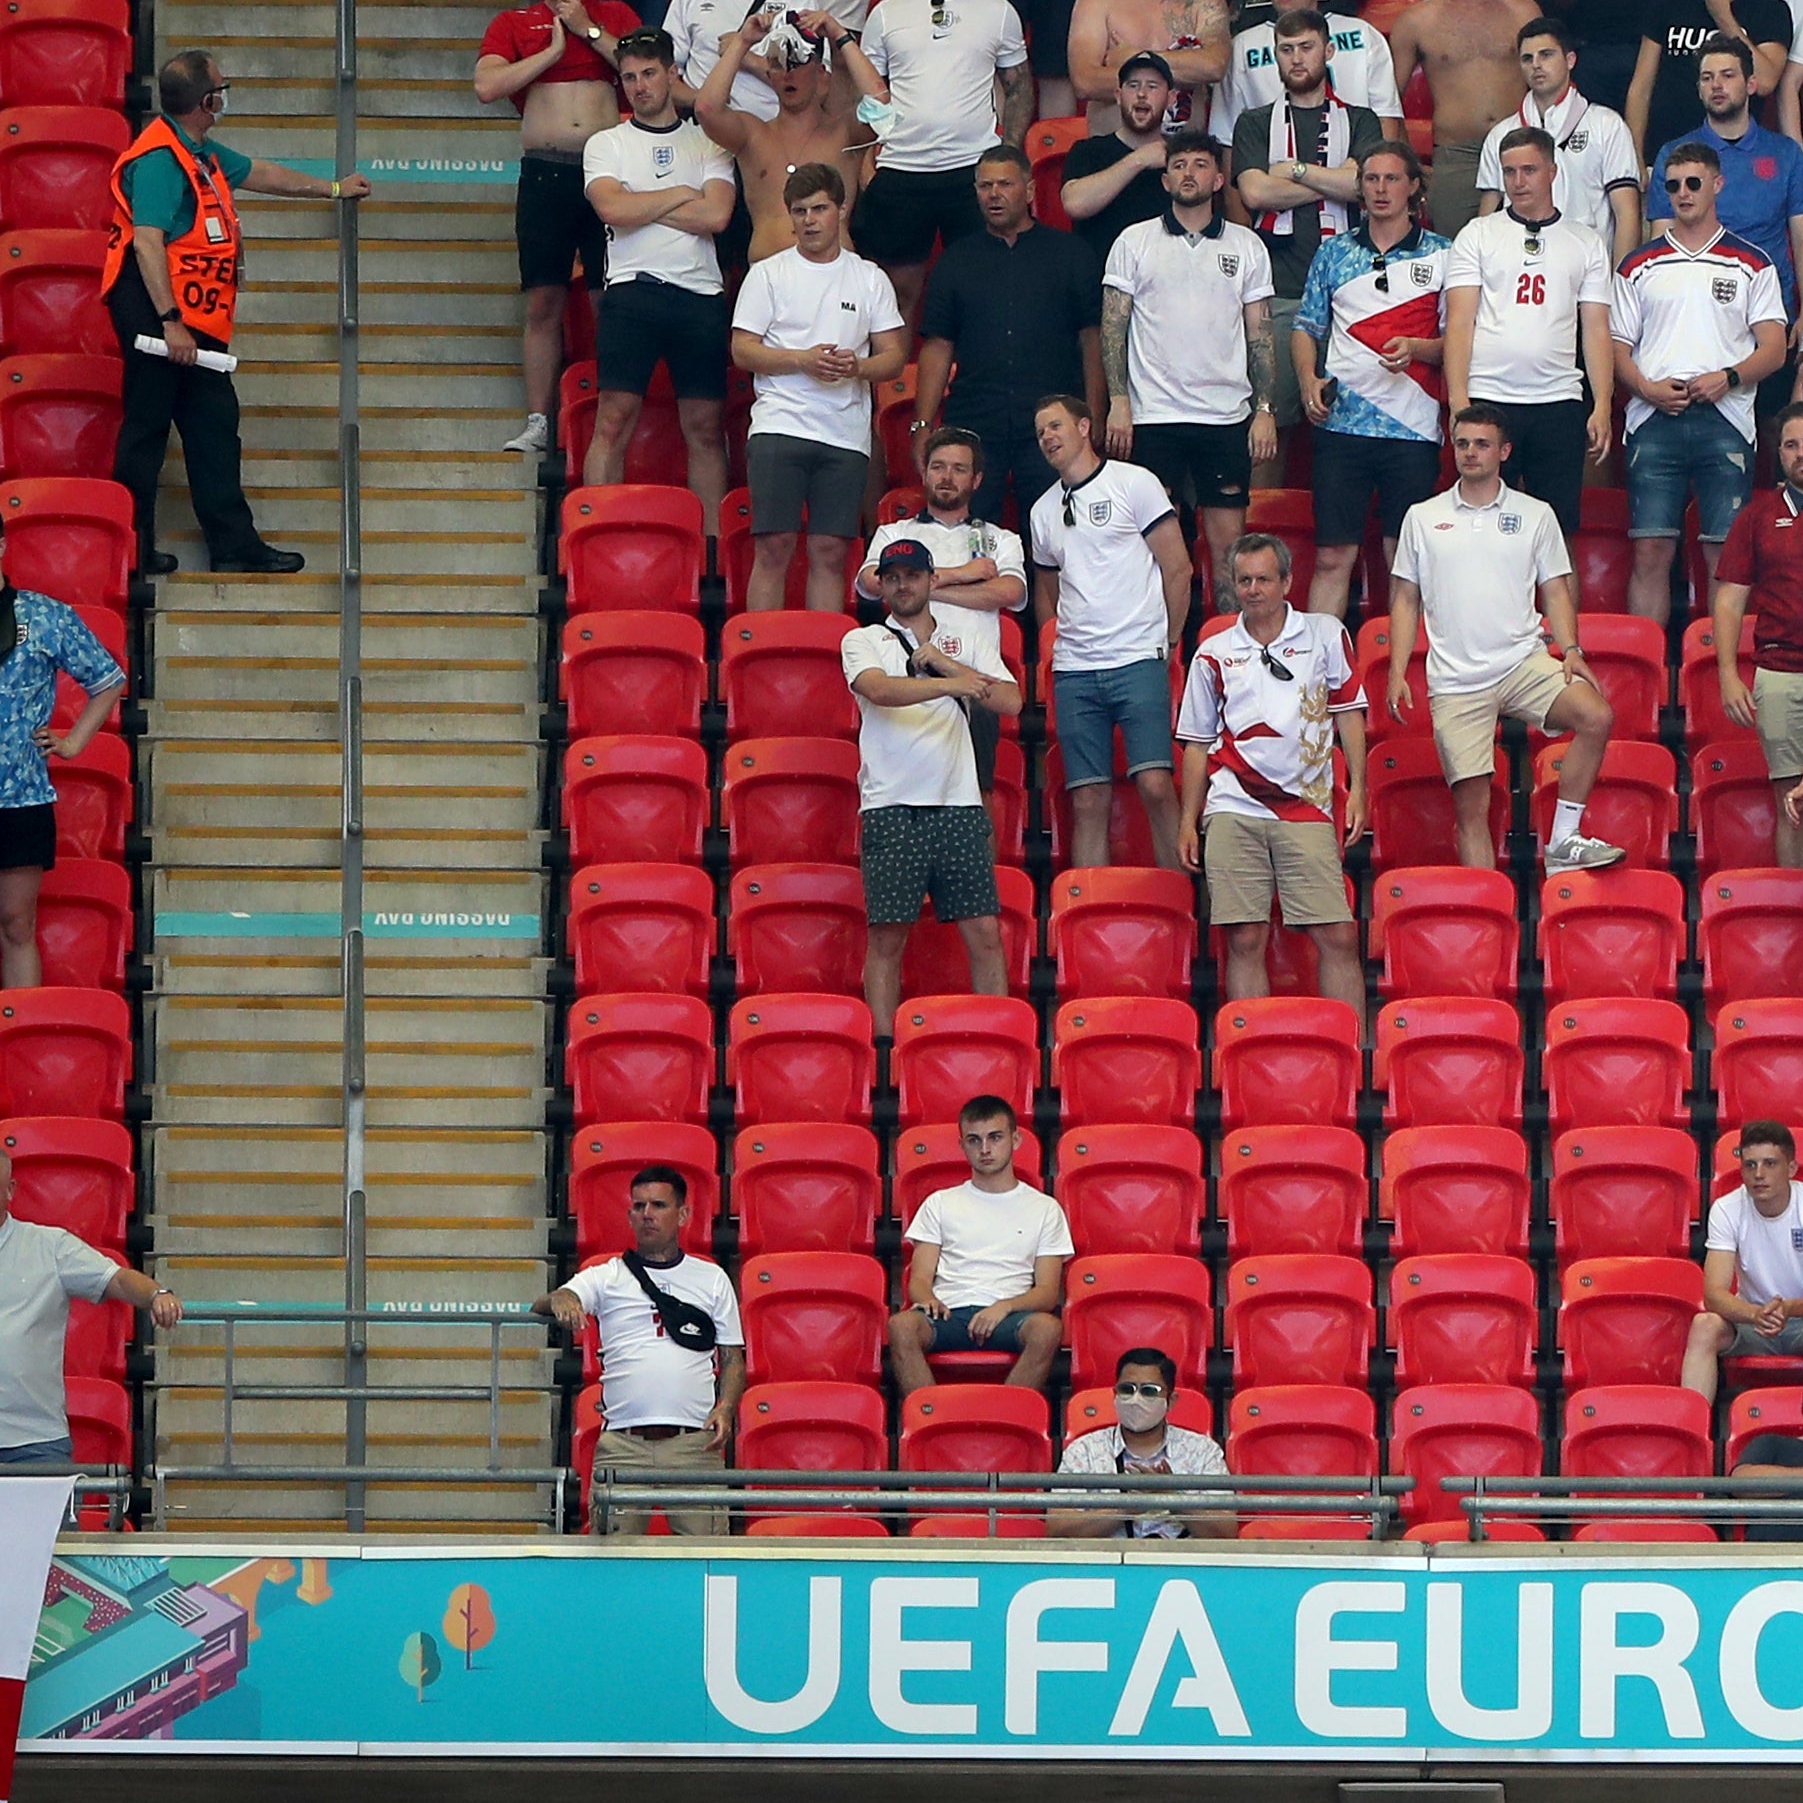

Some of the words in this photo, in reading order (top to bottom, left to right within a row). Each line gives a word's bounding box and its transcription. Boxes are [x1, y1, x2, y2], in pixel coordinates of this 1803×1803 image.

[1516, 273, 1545, 305] 26
[841, 302, 856, 312] MA
[885, 542, 914, 557] ENG
[704, 1576, 1252, 1738] UEFA
